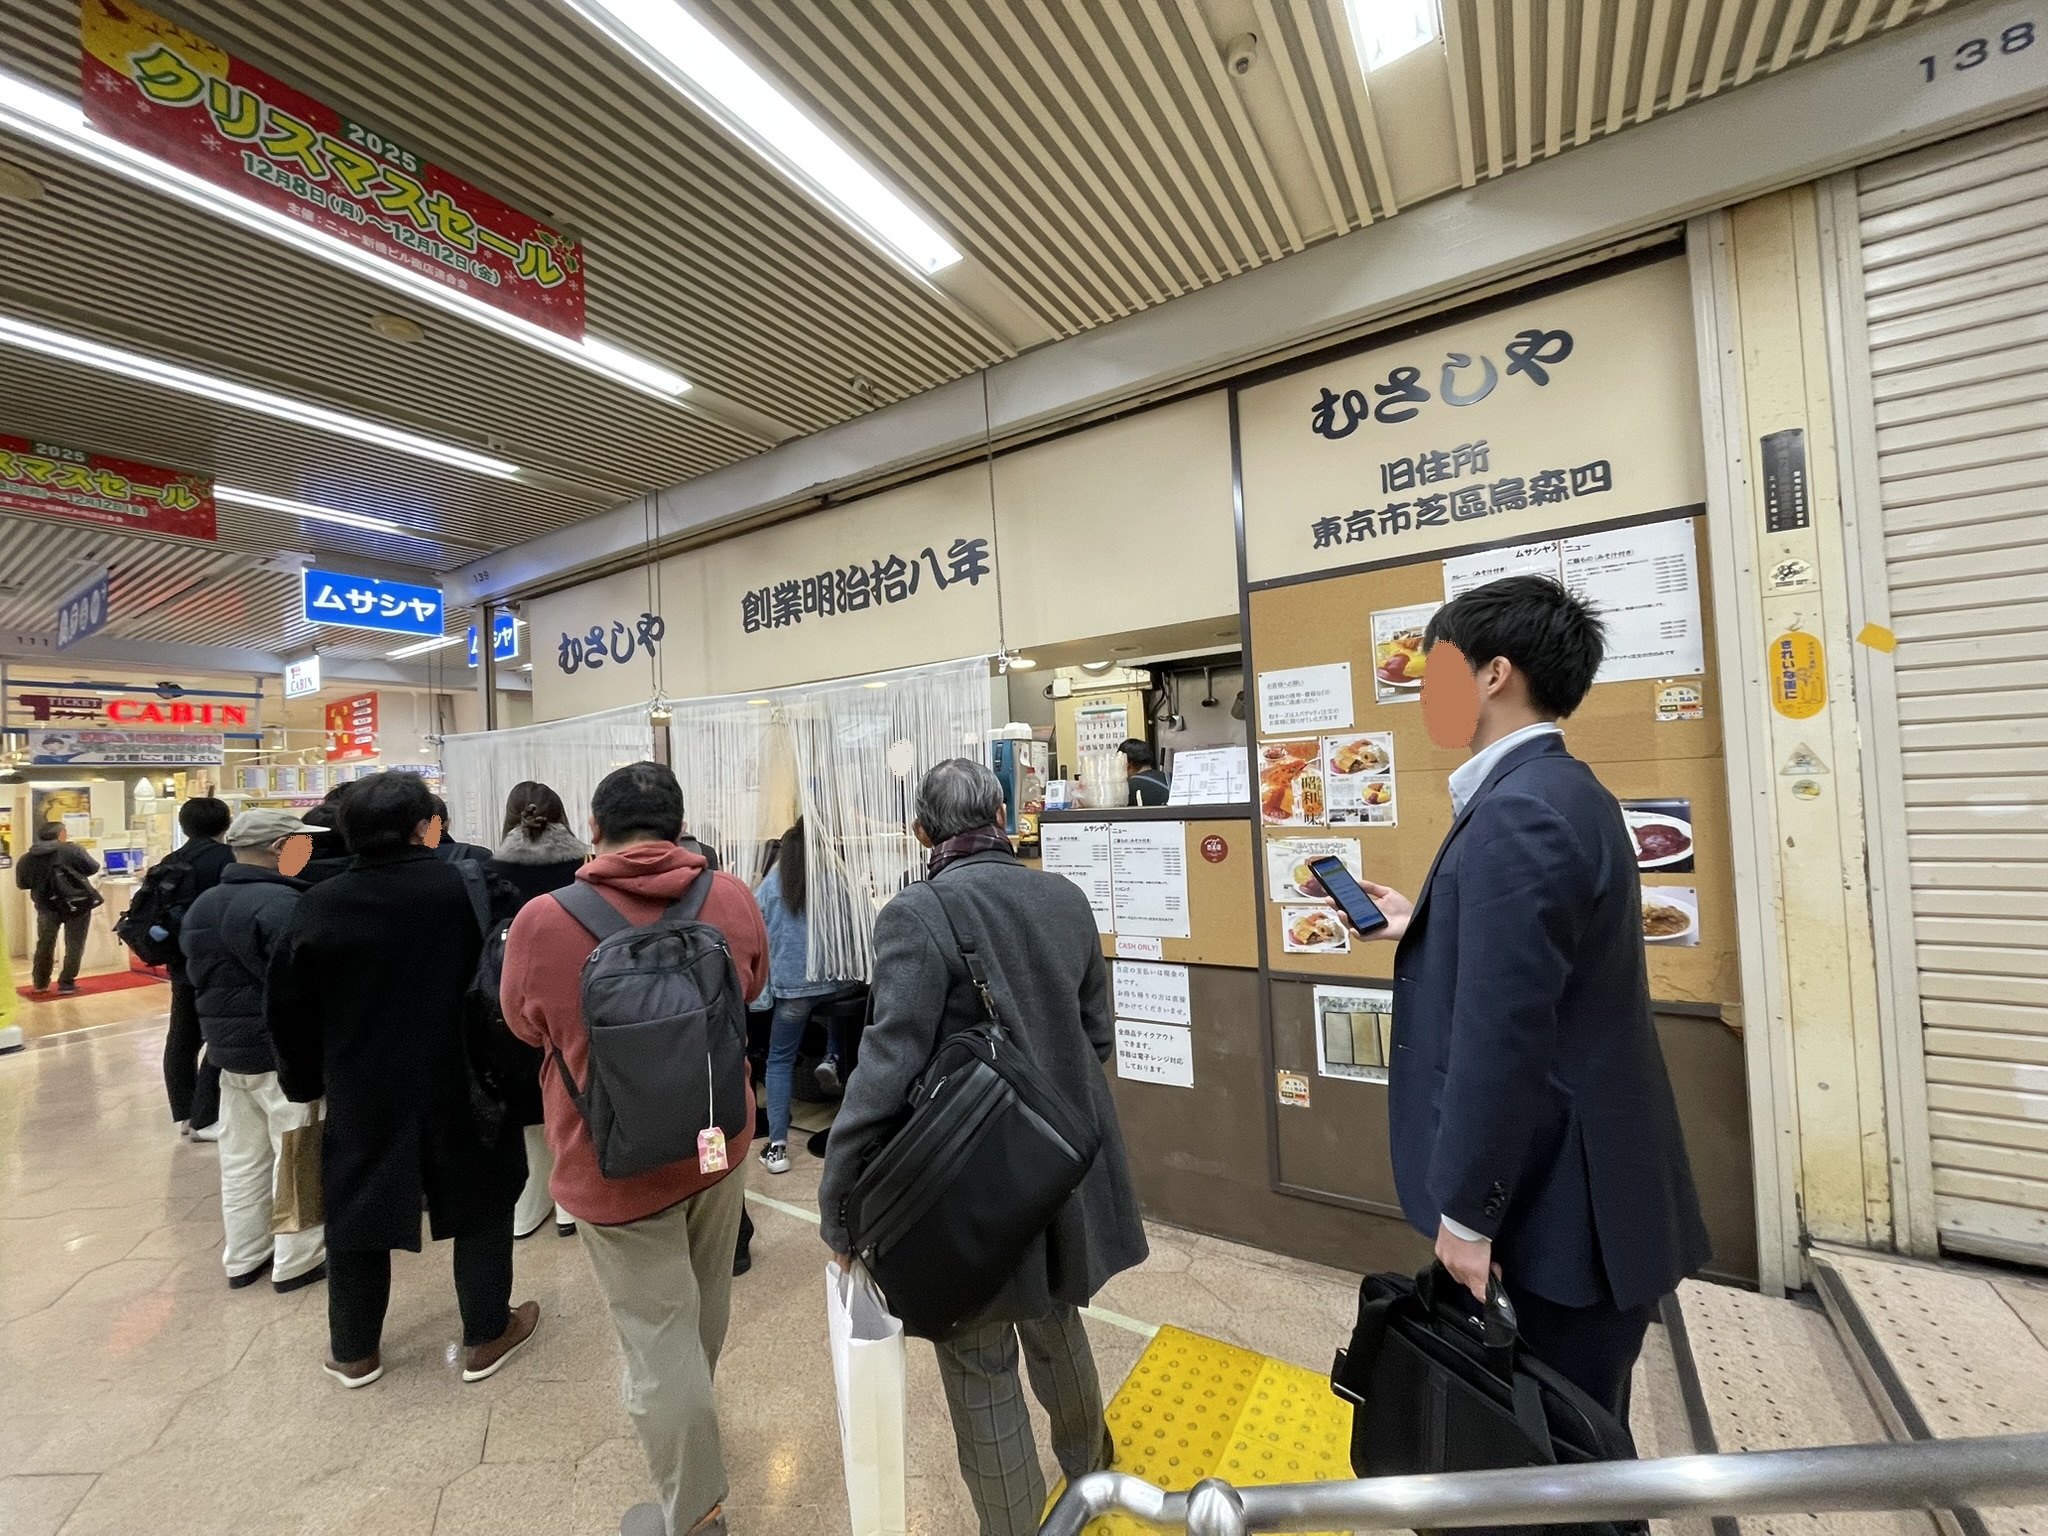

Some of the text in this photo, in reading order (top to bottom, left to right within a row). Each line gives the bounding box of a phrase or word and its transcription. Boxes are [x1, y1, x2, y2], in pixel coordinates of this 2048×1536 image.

[1919, 21, 2036, 83] 138
[347, 123, 418, 173] 2025
[131, 43, 566, 288] クリスマスセール
[1311, 327, 1574, 440] むさしや
[36, 443, 86, 463] 2025
[1380, 439, 1490, 494] 旧住所
[473, 571, 490, 583] 139
[742, 538, 991, 634] 創業明治拾八年
[312, 584, 437, 622] ムサシヤ
[558, 613, 665, 675] むさしや
[291, 676, 313, 692] CABIN
[47, 697, 100, 707] TICKET
[106, 699, 249, 726] CABIN
[1301, 776, 1319, 826] 昭和の味
[1118, 942, 1159, 952] CASH ONLY!
[1116, 966, 1185, 978] 当店の支払いは現金の
[1117, 978, 1139, 987] みです。
[1117, 990, 1186, 1003] お持ち帰りの方は直接
[1118, 1028, 1175, 1041] 全商品テイクアウト
[1123, 1040, 1152, 1051] できます。
[1119, 1050, 1184, 1066] 容器は電子レンジ対応
[1125, 1061, 1166, 1075] しております。
